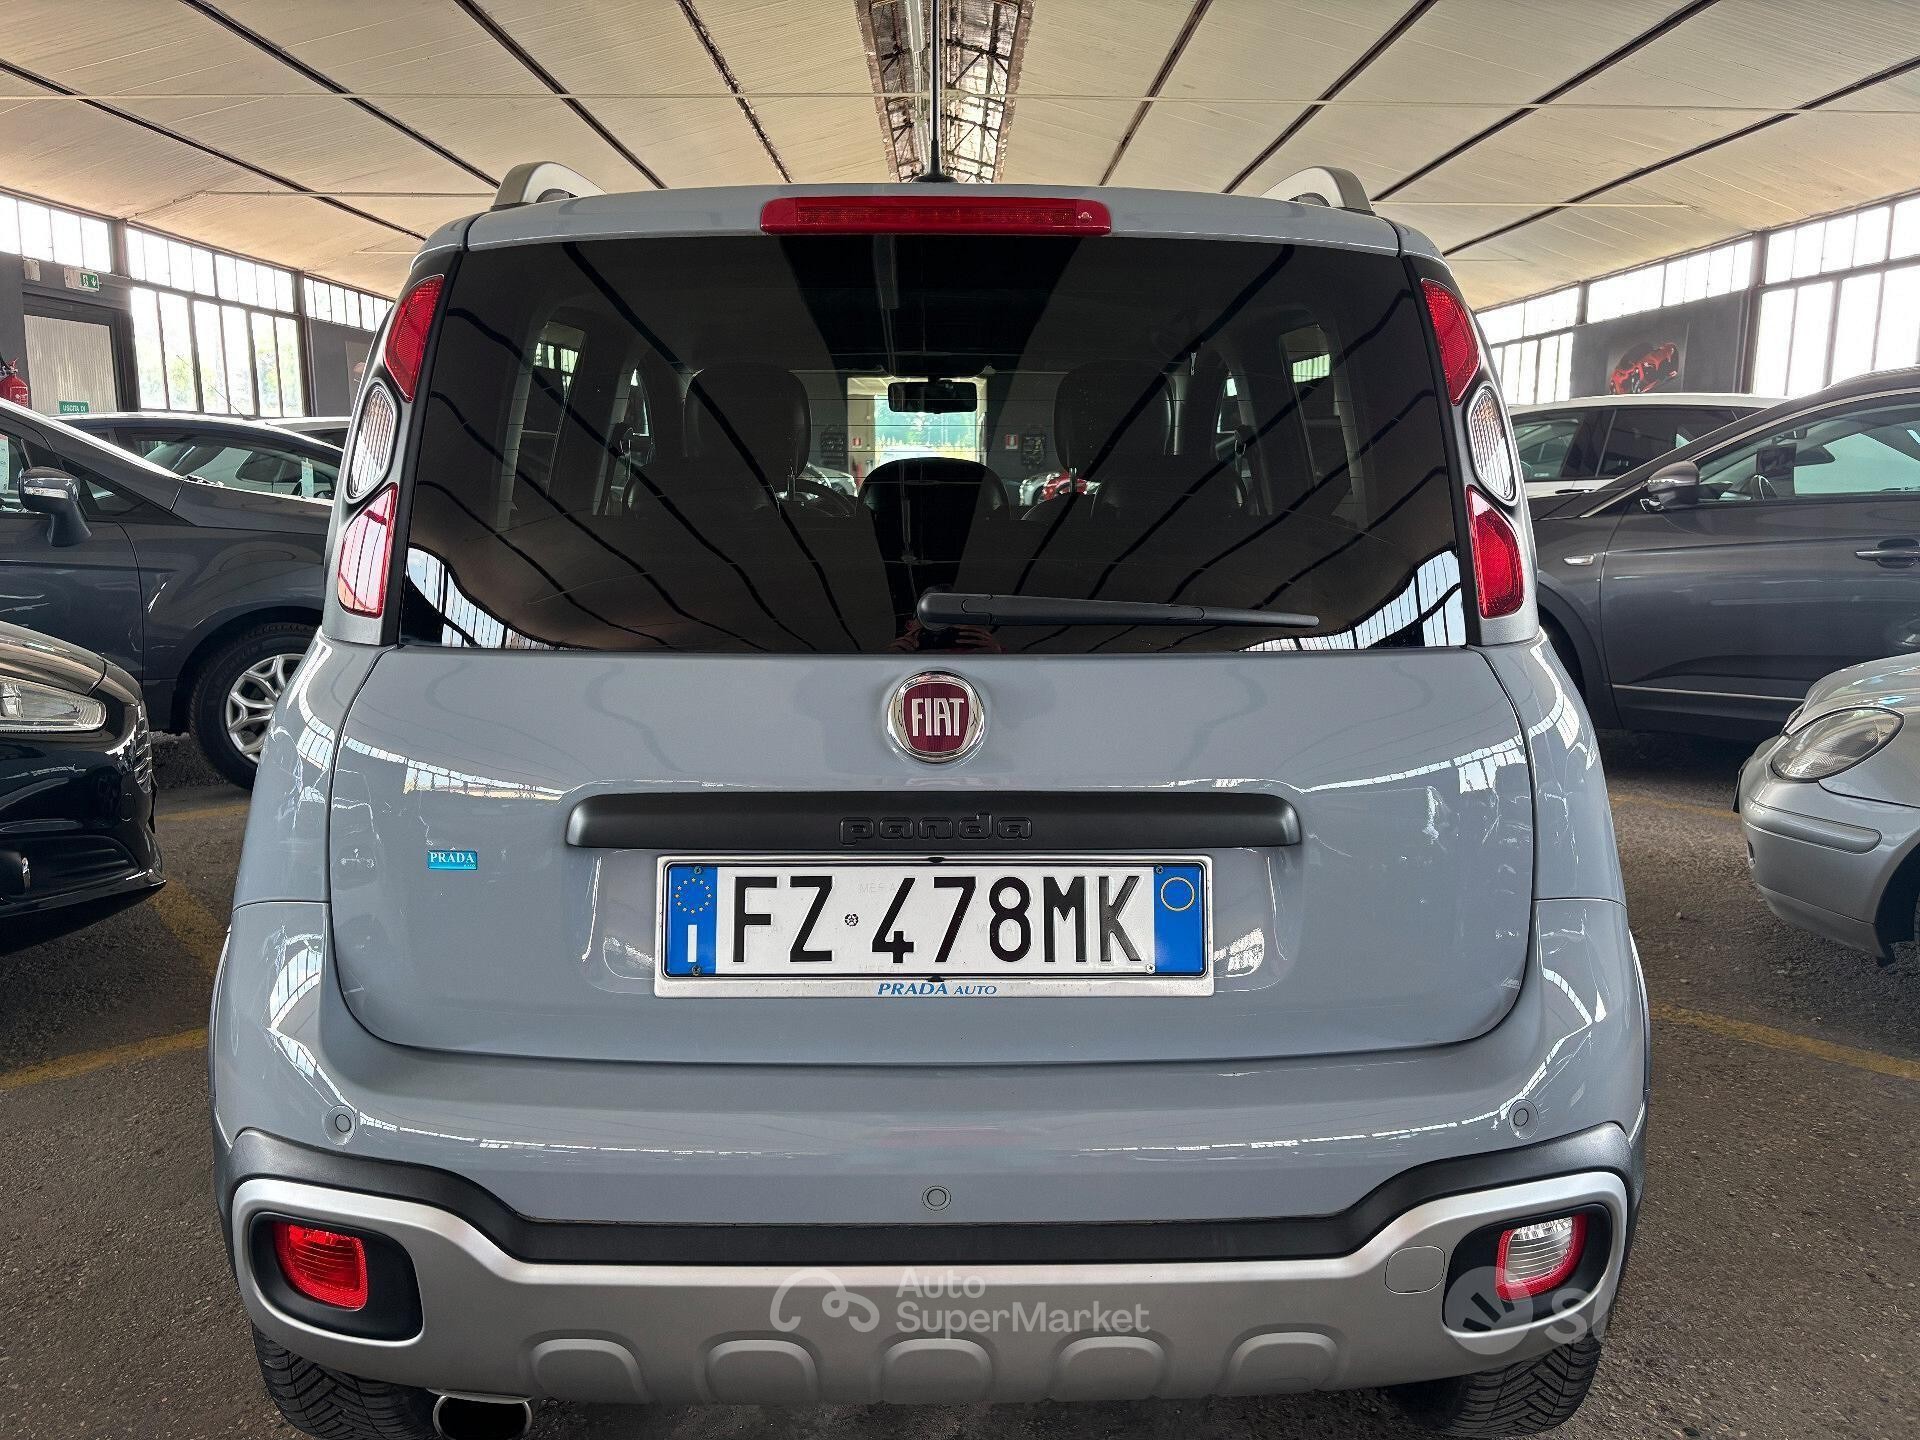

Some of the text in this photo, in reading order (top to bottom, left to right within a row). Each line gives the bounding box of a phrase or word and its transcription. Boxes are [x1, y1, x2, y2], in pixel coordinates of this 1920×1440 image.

[911, 697, 965, 737] FIAT
[839, 811, 1032, 846] panda
[430, 851, 475, 863] PRADA
[687, 924, 697, 963] I
[877, 982, 998, 996] PRADA AUTO
